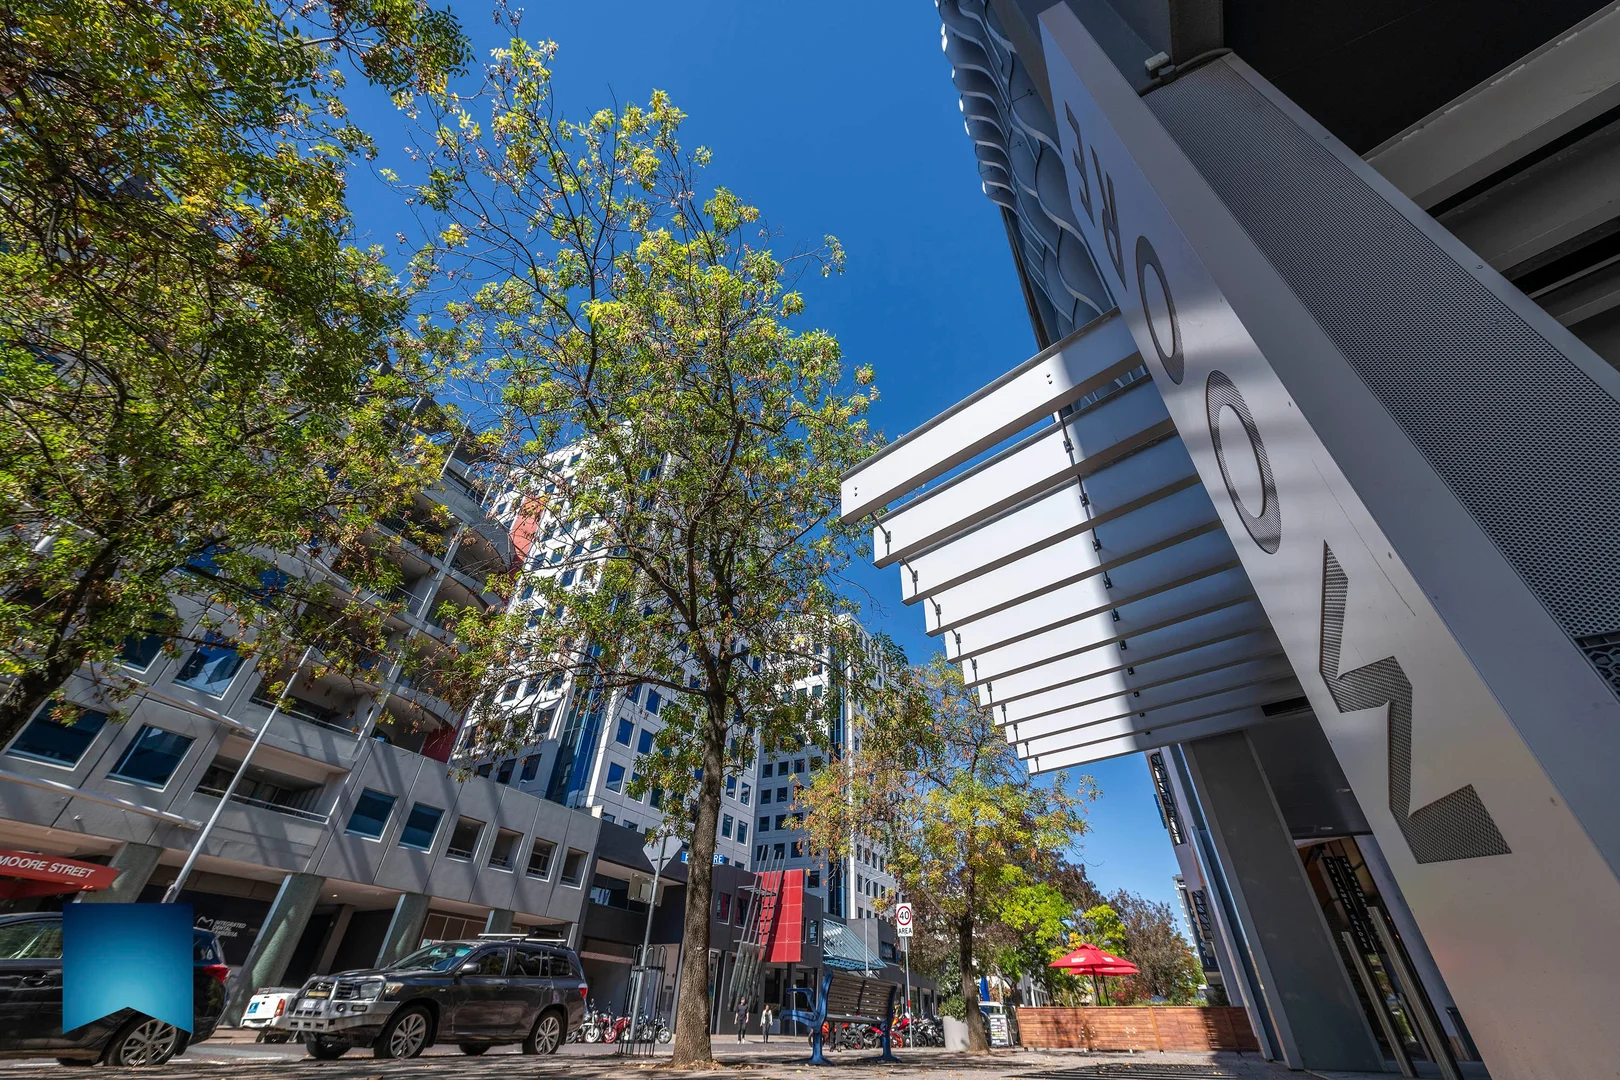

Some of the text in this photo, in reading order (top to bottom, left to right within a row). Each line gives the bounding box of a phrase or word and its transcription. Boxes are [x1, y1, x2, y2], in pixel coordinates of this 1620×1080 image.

[1064, 100, 1511, 864] MOORE
[0, 856, 95, 878] MOORE STREET
[900, 911, 909, 920] 40
